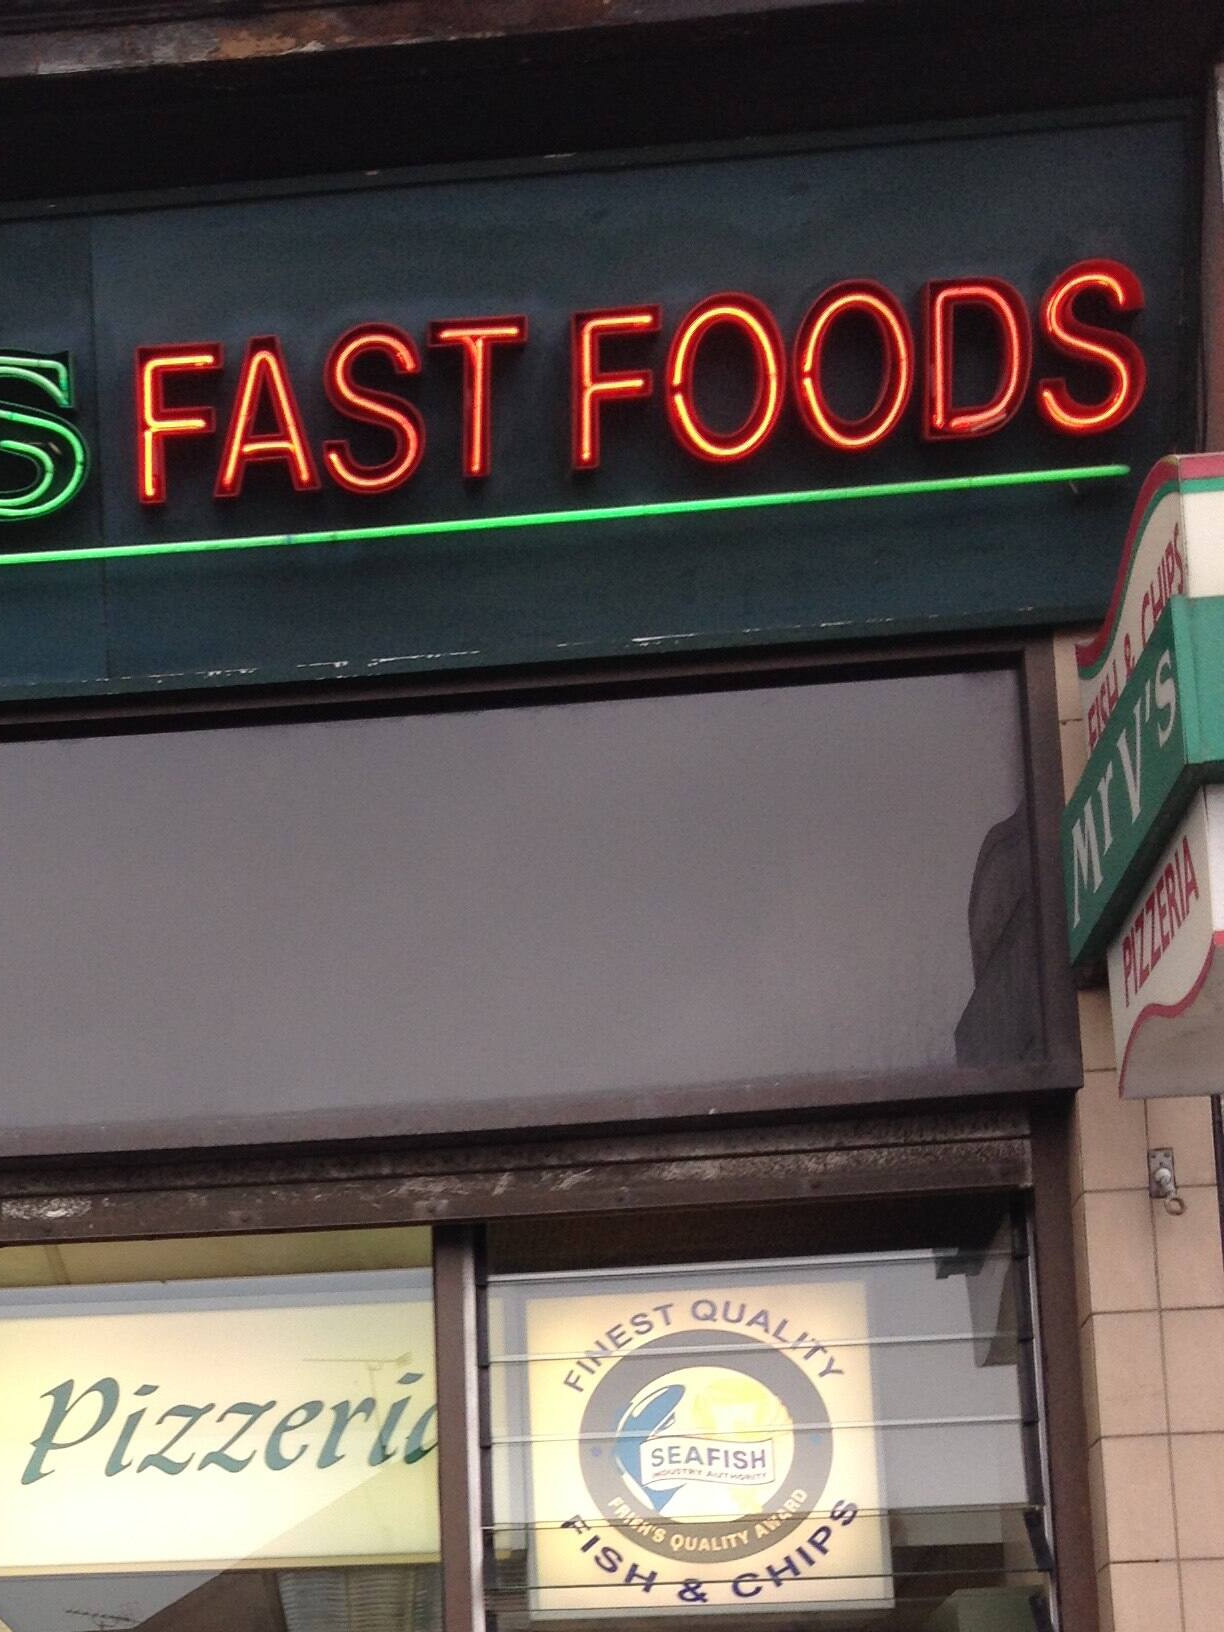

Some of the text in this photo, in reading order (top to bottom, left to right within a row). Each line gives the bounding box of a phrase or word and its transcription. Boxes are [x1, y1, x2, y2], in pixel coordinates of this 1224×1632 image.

[134, 314, 527, 505] FAST
[570, 258, 1147, 472] FOODS
[1122, 834, 1200, 1008] PIZZERIA
[563, 1299, 845, 1393] FINEST QUALITY
[651, 1444, 767, 1470] SEAFISH
[560, 1499, 859, 1605] FISH & CHIPS
[670, 1530, 749, 1551] QUALITY
